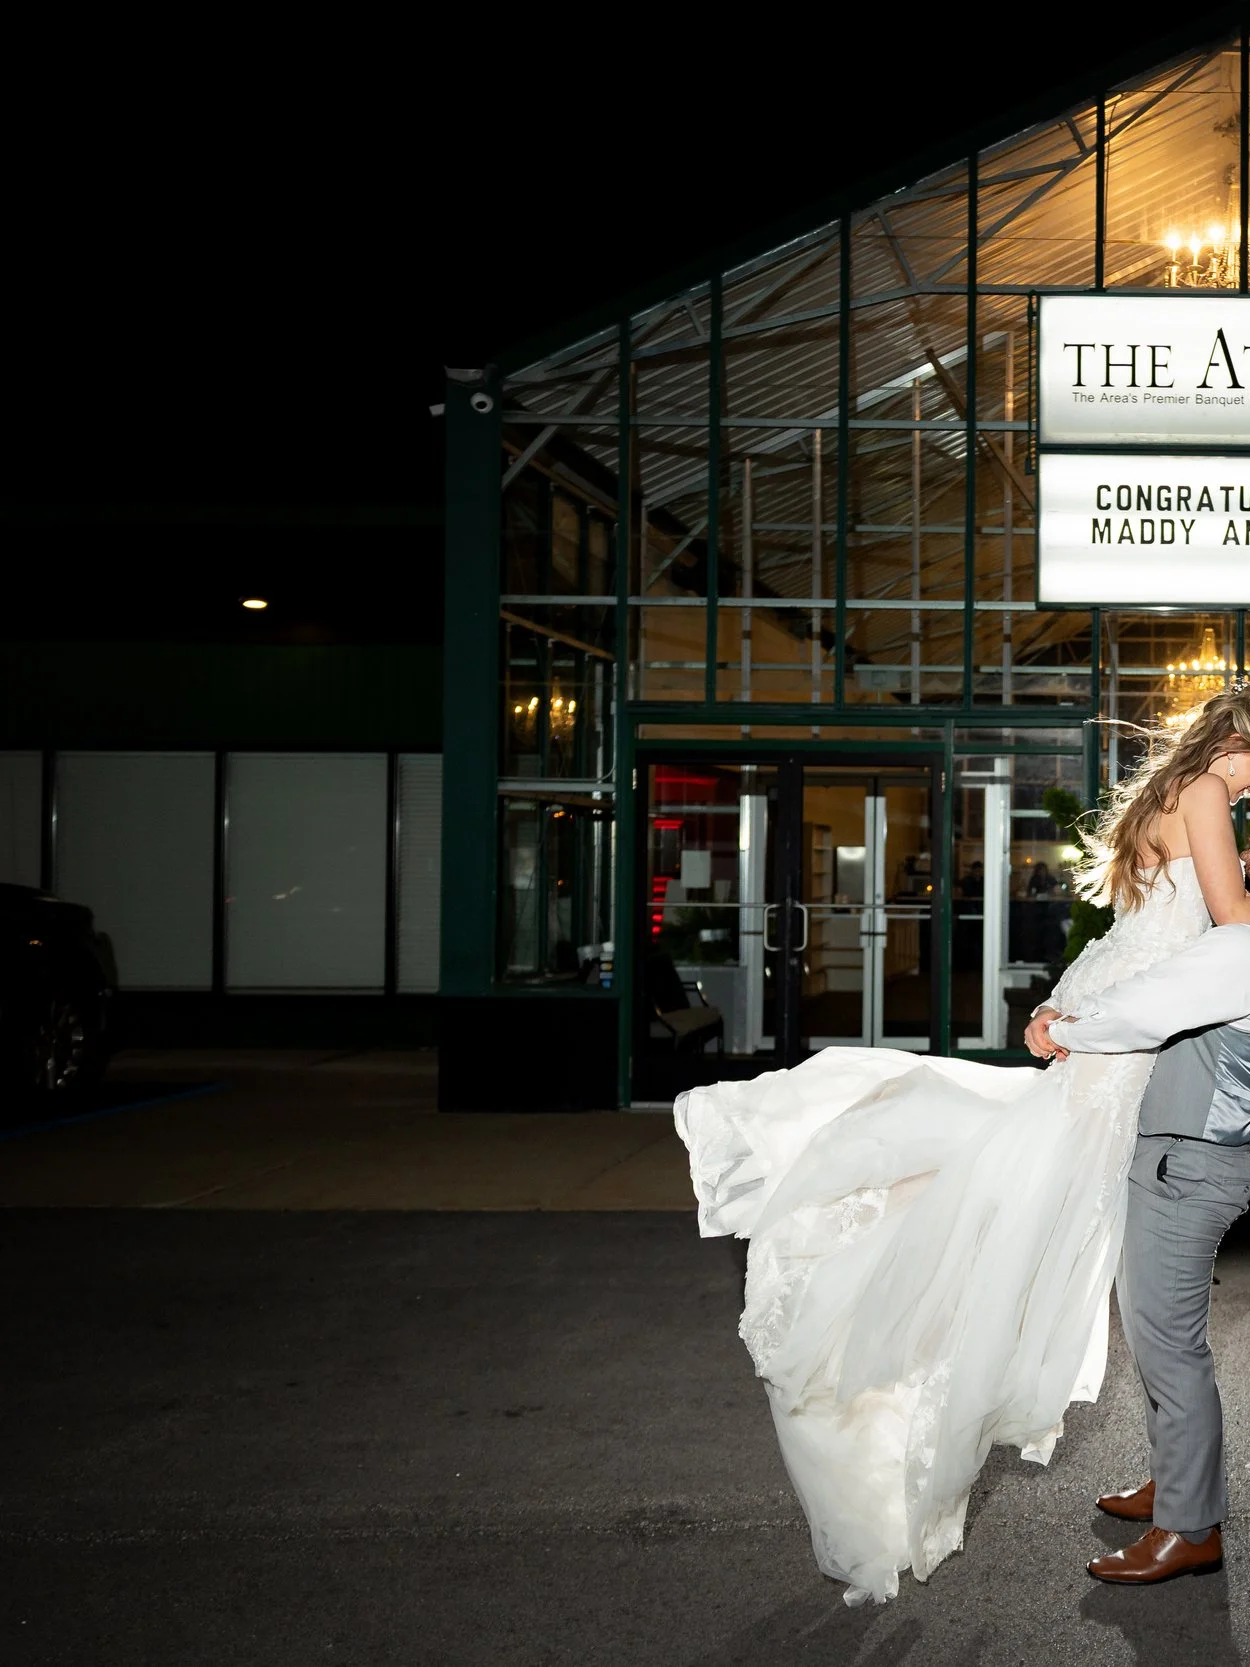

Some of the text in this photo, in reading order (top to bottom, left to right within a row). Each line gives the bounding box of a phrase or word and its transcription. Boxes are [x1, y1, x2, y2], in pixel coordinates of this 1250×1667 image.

[1063, 342, 1175, 389] THE
[1072, 392, 1095, 404] The
[1100, 392, 1138, 405] Area's
[1143, 393, 1190, 405] Premier
[1195, 394, 1245, 408] Banquet
[1091, 517, 1196, 545] MADDY
